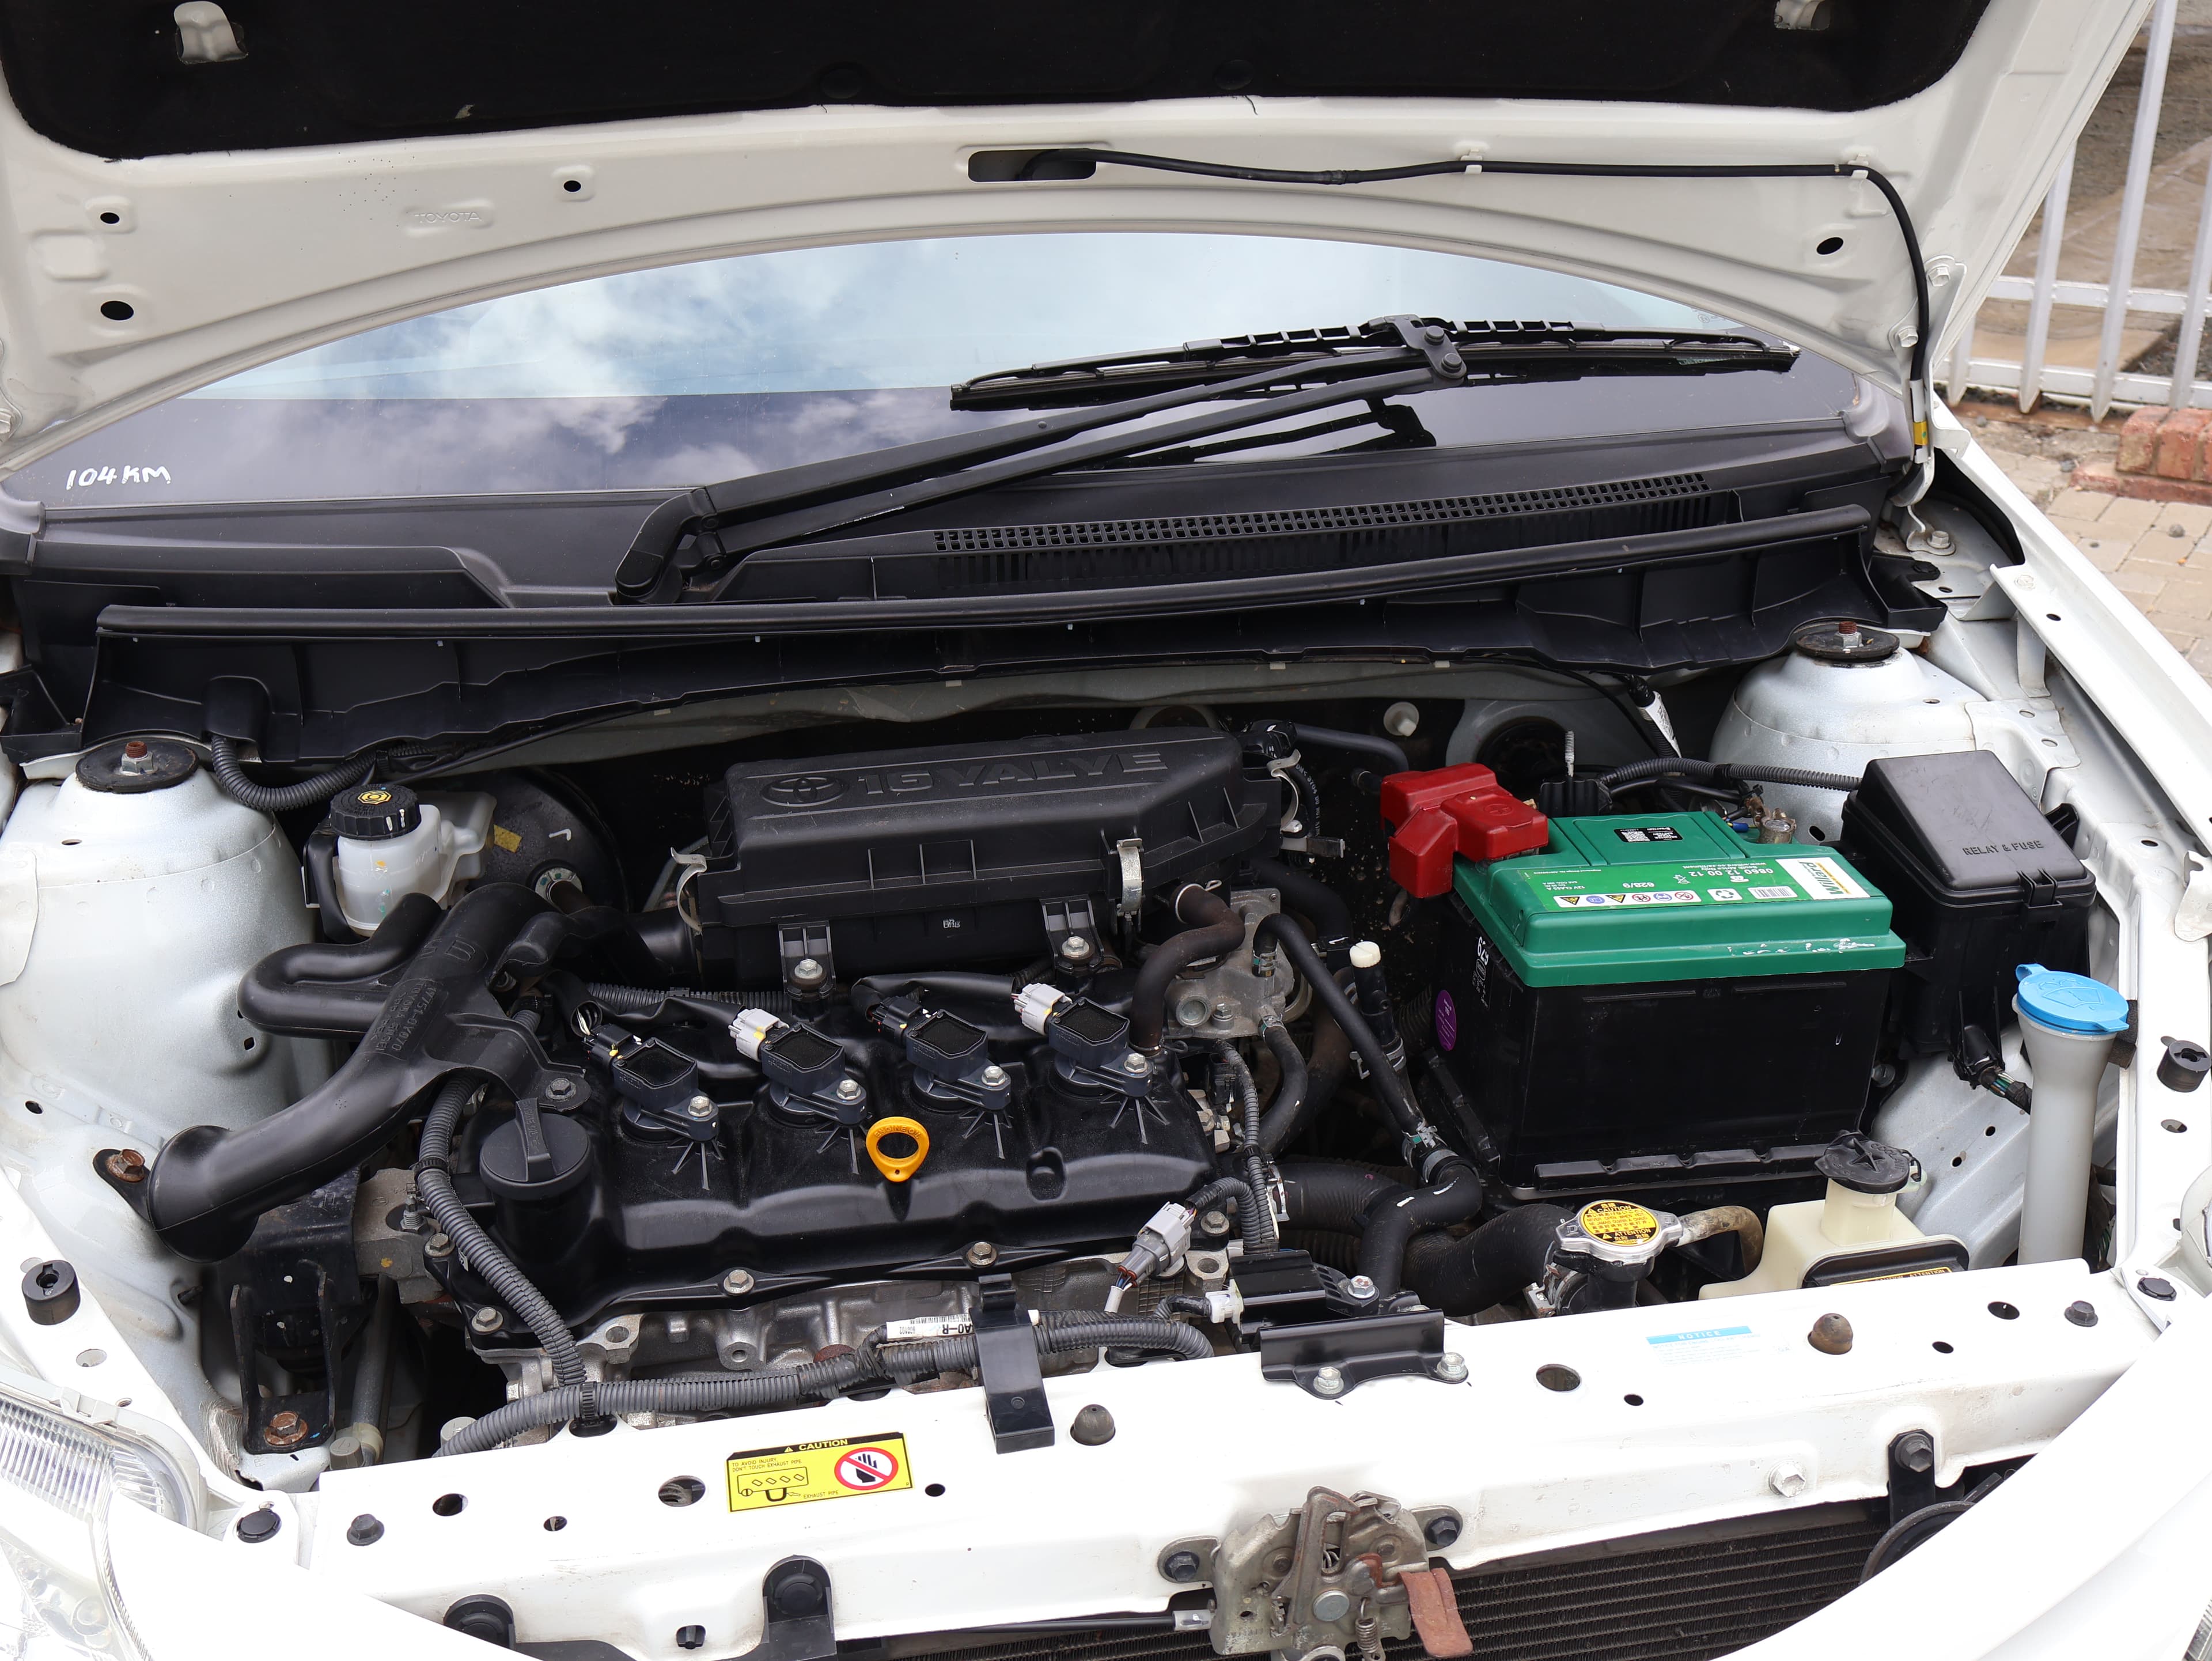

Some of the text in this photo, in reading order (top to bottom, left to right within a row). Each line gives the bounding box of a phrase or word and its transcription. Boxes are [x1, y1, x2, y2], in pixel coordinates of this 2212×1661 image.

[414, 211, 482, 224] TOYOTA
[858, 751, 1168, 794] 16 VALVE
[1962, 840, 2045, 856] RELAY & FUSE
[1798, 861, 1844, 895] Willard
[874, 1124, 922, 1139] ENGINE OIL
[1615, 1228, 1652, 1237] ATTENTION
[1677, 1330, 1722, 1340] NOTICE
[798, 1439, 849, 1452] CAUTION
[740, 1459, 757, 1467] AVOID
[767, 1461, 790, 1469] EXHAUST
